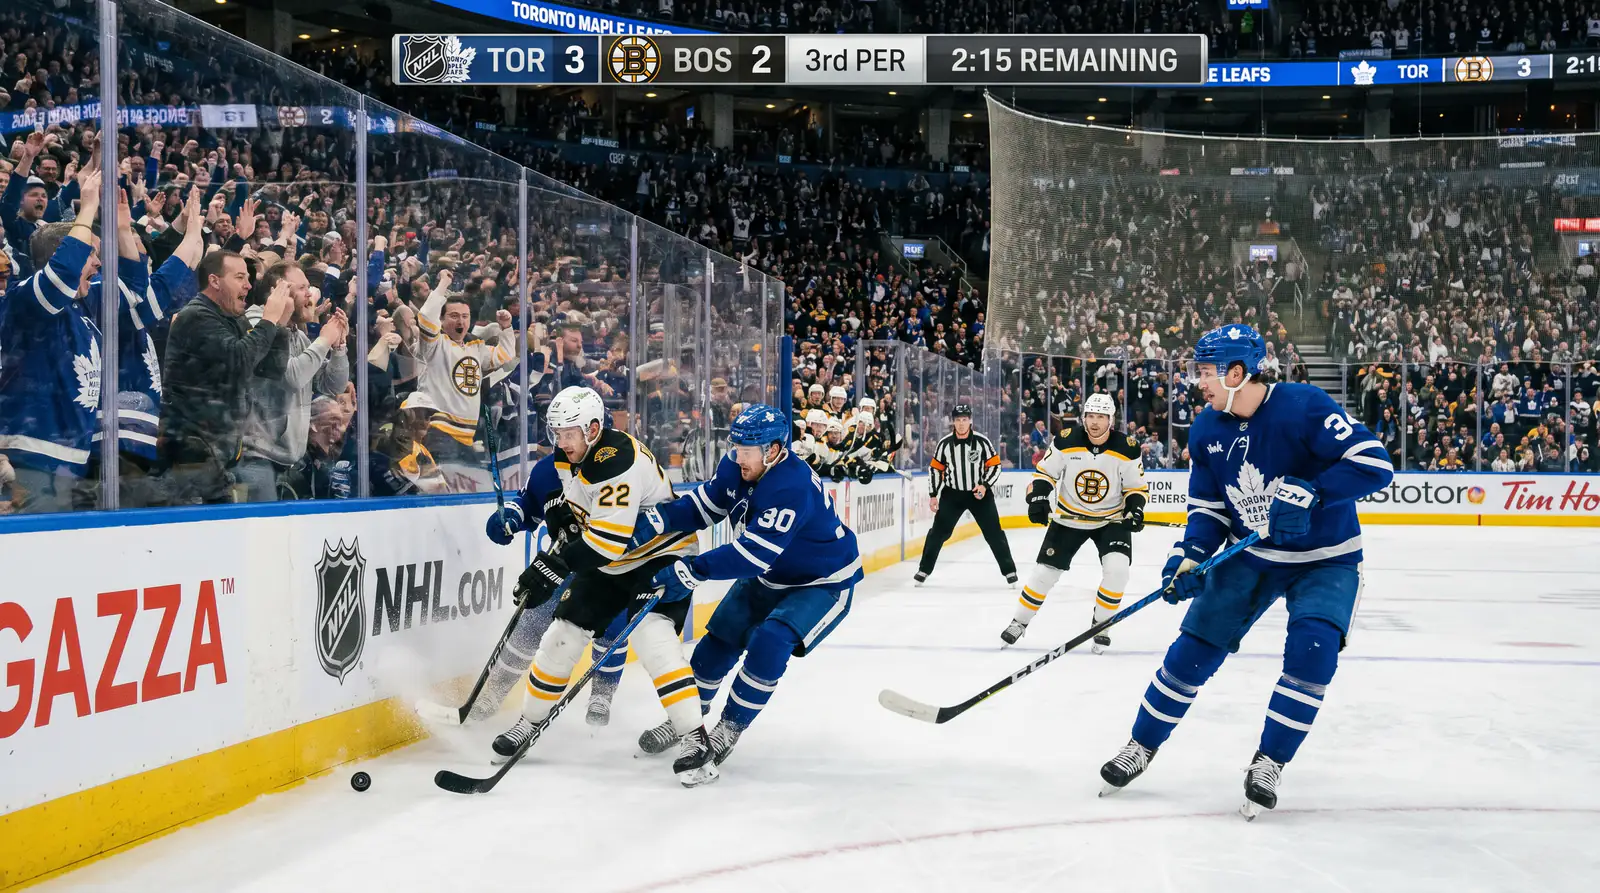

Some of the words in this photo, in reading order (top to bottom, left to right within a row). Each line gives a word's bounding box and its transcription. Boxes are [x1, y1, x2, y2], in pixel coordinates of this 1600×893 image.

[512, 1, 576, 28] TORONTO
[578, 15, 625, 34] MAPLE
[1222, 67, 1271, 82] LEAFS
[1397, 64, 1429, 79] TOR
[1517, 58, 1531, 77] 3
[1566, 55, 1600, 74] 2:1
[599, 482, 630, 507] 22
[1147, 481, 1172, 490] TION
[1502, 480, 1553, 511] Tim
[1237, 494, 1273, 509] TORONT
[1245, 505, 1270, 514] MAPL
[757, 507, 796, 533] 30
[372, 560, 504, 637] NHL.COM
[327, 578, 357, 649] NHL
[0, 579, 228, 739] GAZZA
[221, 577, 235, 595] TM
